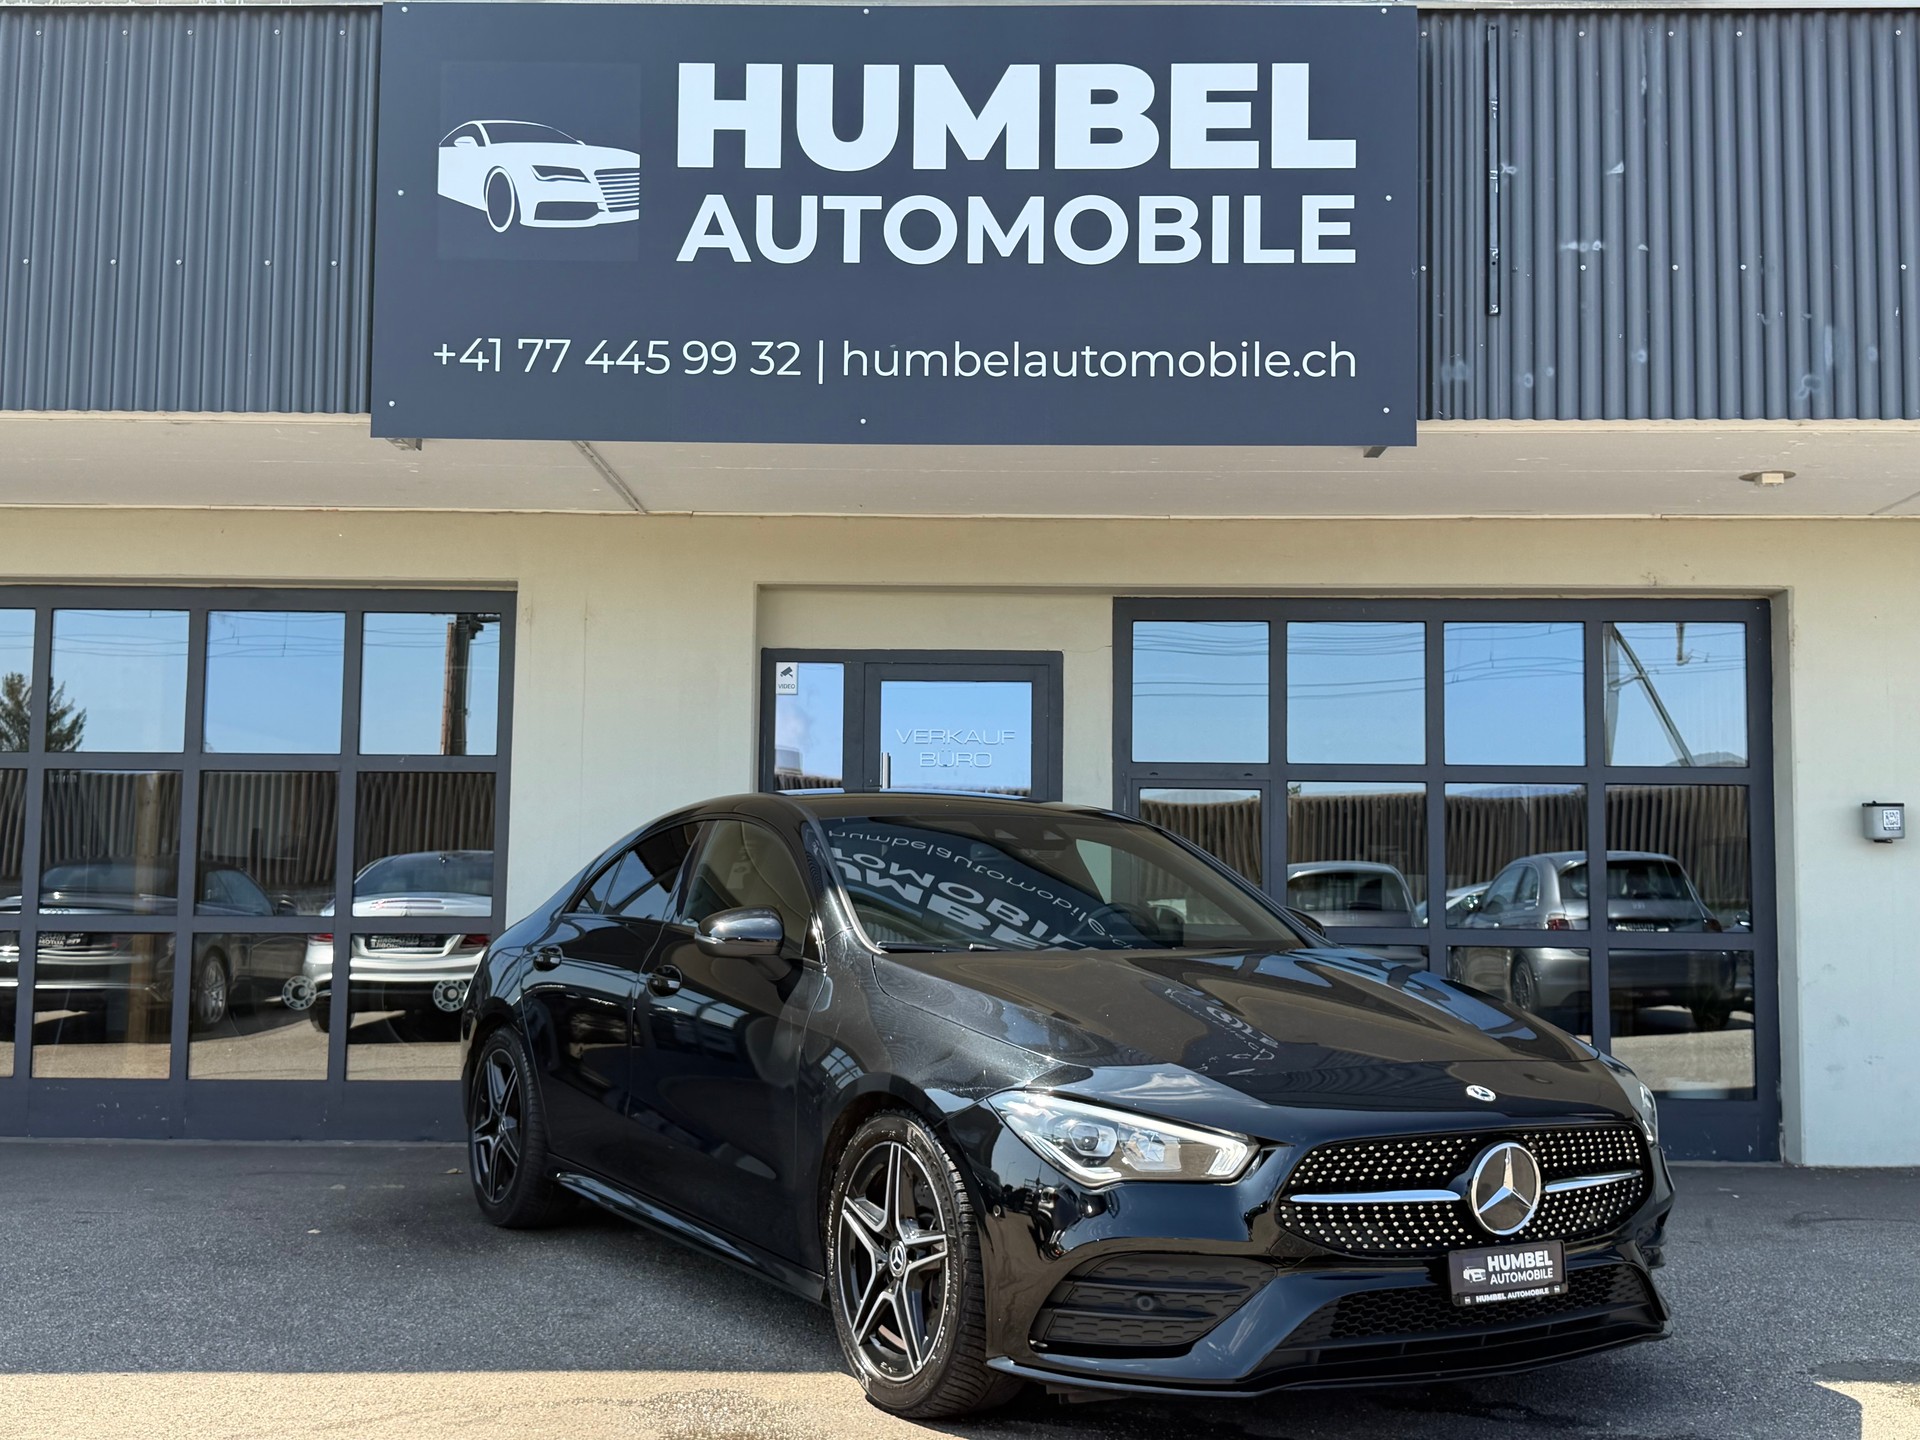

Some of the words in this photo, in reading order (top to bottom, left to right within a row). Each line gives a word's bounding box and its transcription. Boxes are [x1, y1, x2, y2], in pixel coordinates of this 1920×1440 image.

[676, 62, 1358, 172] HUMBEL
[675, 193, 1357, 266] AUTOMOBILE
[433, 337, 502, 373] +41
[517, 338, 573, 374] 77
[584, 338, 672, 376] 445
[682, 340, 738, 376] 99
[749, 341, 803, 377] 32
[842, 339, 1358, 379] humbelautomobile.ch
[896, 729, 1015, 745] VERKAUF
[919, 749, 993, 768] BÜRO
[1487, 1250, 1553, 1272] HUMBEL
[1490, 1268, 1554, 1285] AUTOMOBILE
[1476, 1293, 1506, 1303] HUMBEL
[1507, 1287, 1549, 1299] AUTOMOBILE
